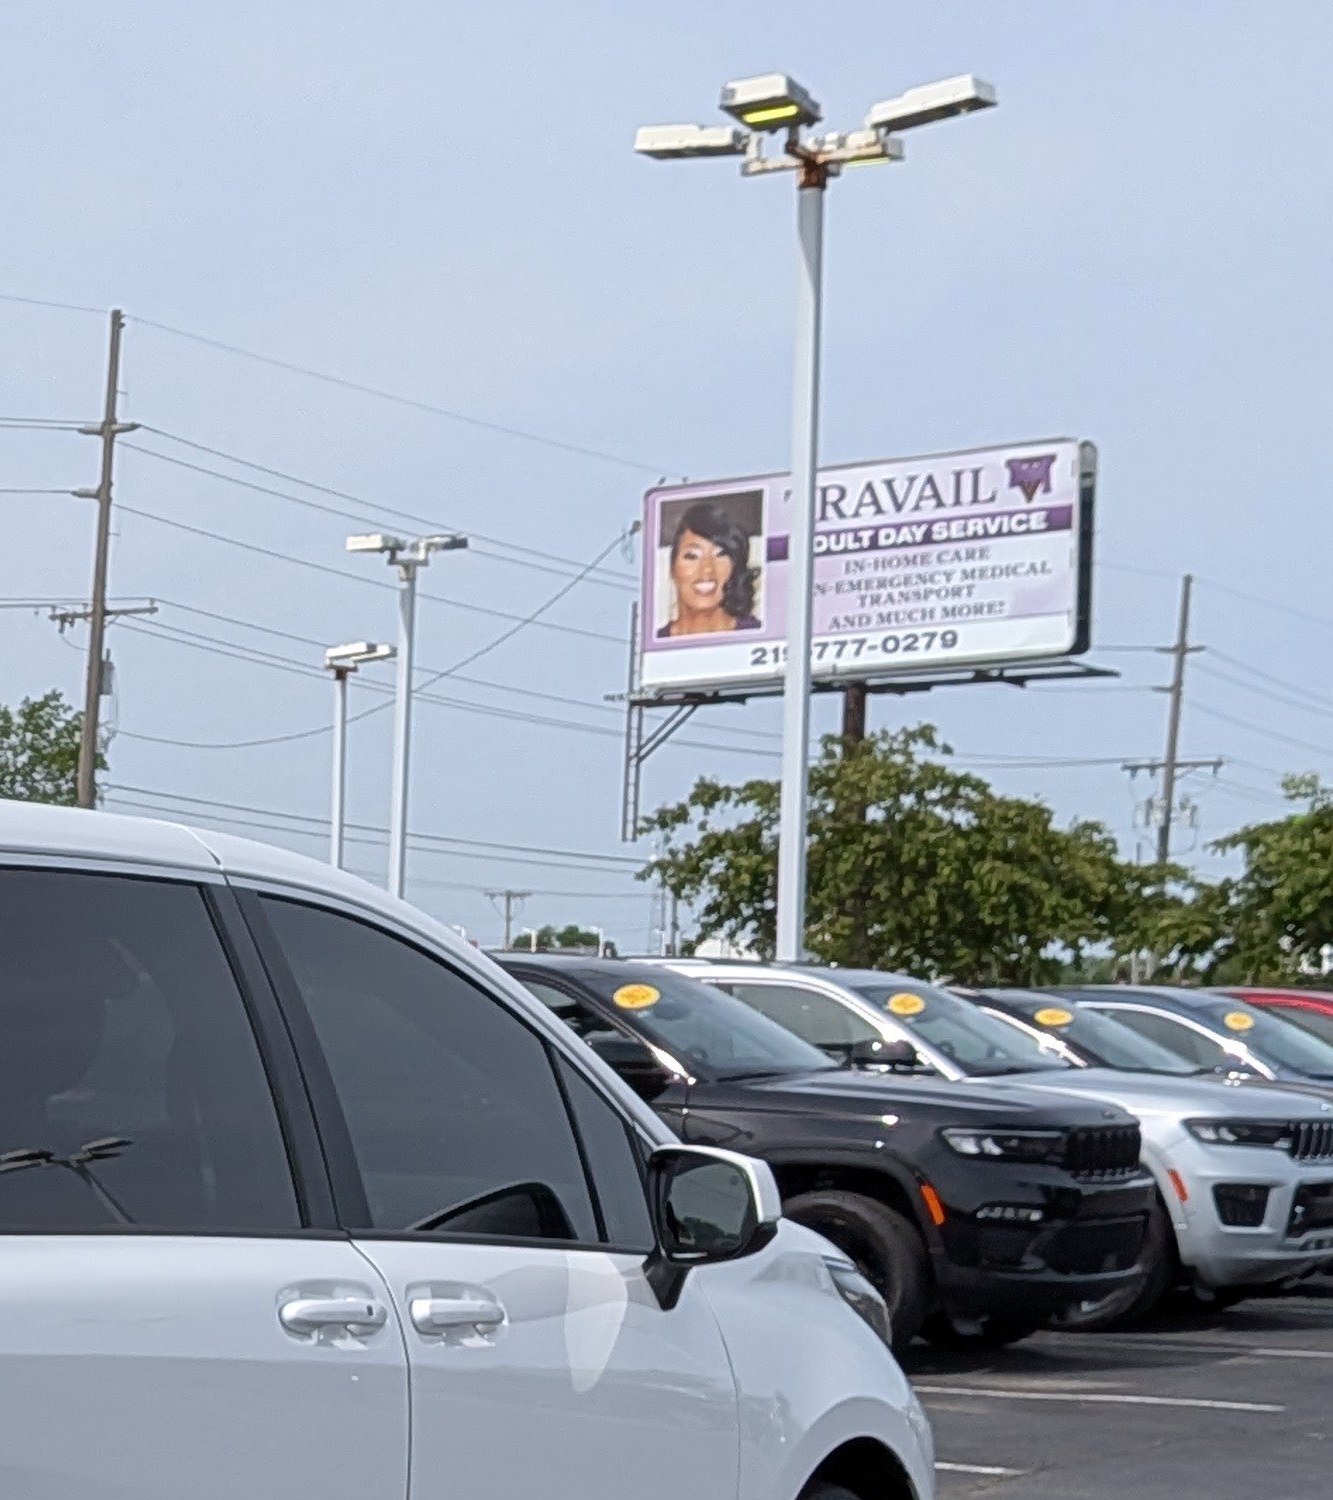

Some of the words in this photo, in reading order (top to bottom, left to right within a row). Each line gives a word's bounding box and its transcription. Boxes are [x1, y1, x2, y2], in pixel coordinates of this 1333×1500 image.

[784, 467, 997, 520] RAVAIL
[813, 529, 874, 553] DULT
[878, 523, 928, 547] DAY
[931, 511, 1049, 541] SERVICE
[844, 552, 933, 574] IN-HOME
[936, 546, 991, 564] CARE
[960, 560, 1052, 582] MEDICAL
[857, 584, 976, 608] TRANSPORT
[828, 612, 872, 631] AND
[876, 606, 937, 626] MUCH
